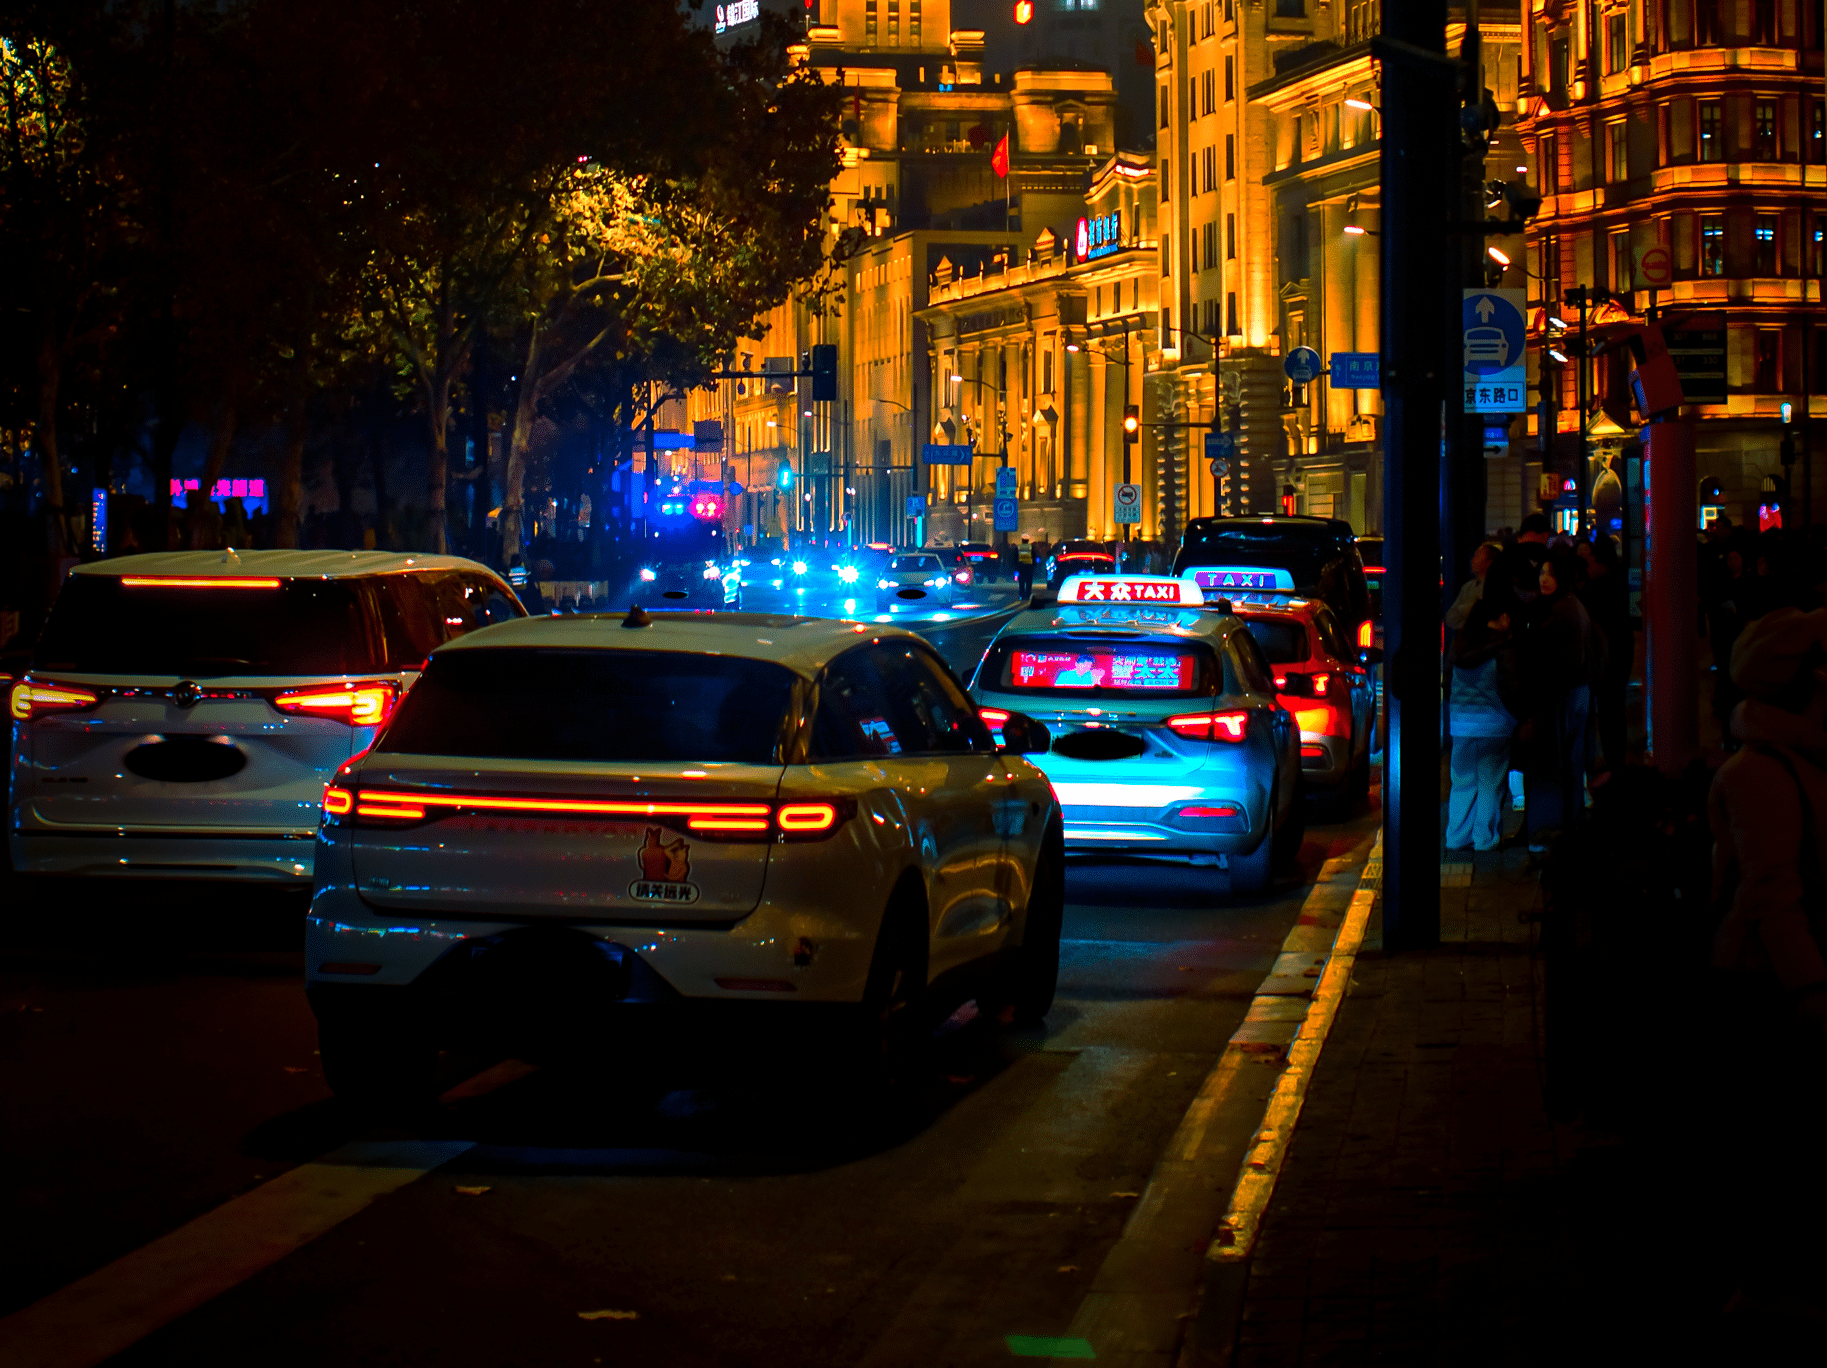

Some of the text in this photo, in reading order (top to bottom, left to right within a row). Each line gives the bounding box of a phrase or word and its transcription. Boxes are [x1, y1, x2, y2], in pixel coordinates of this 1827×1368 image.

[1465, 387, 1519, 405] 京东路口
[1207, 573, 1265, 587] TAXI
[1083, 581, 1175, 601] 大众 TAXI
